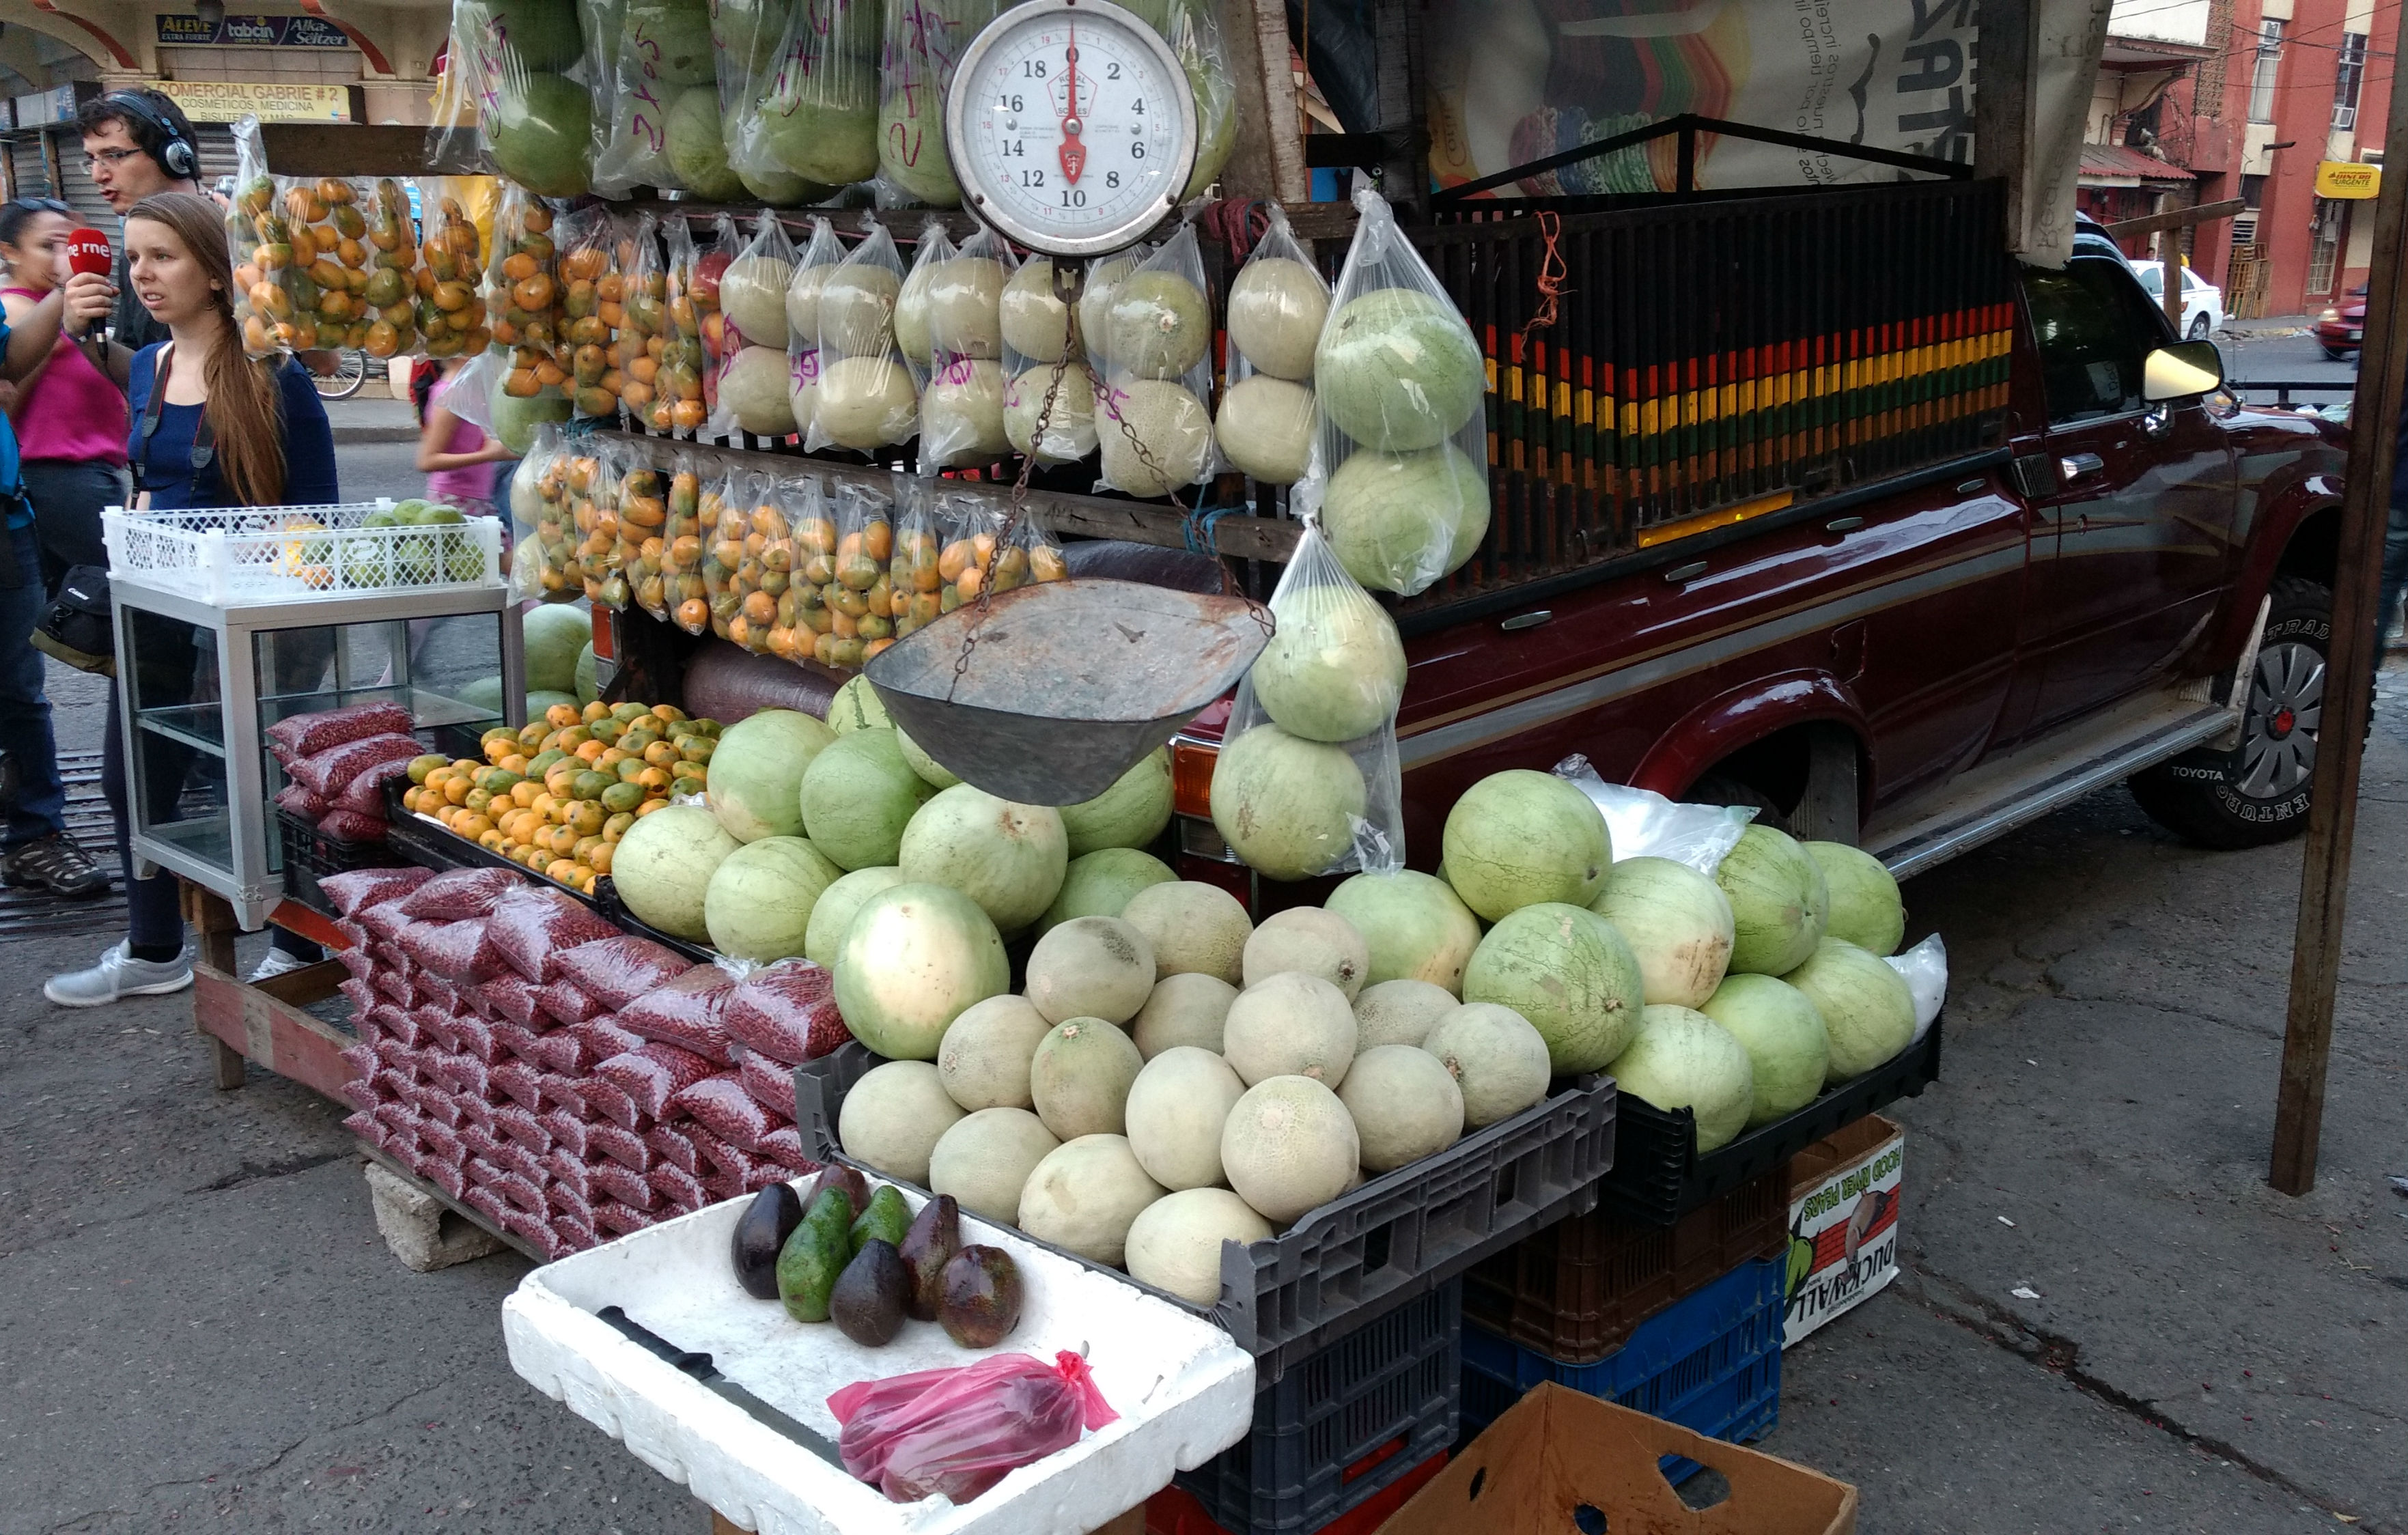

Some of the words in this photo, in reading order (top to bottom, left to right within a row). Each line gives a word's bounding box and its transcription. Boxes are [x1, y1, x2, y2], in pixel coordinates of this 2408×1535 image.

[162, 16, 212, 33] ALEVE
[290, 18, 328, 33] Alka-
[294, 31, 347, 45] Seltzer
[1024, 60, 1046, 78] 18
[1107, 62, 1121, 80] 2
[1059, 74, 1087, 84] ROAL
[157, 83, 250, 98] COMERCIAL
[253, 85, 312, 100] GABRIE
[328, 87, 338, 101] 2
[260, 100, 314, 111] MEDICINA
[1000, 94, 1024, 112] 16
[1131, 98, 1145, 115] 4
[200, 111, 249, 122] BISUTE
[1003, 139, 1024, 156] 14
[1131, 141, 1145, 159] 6
[1022, 170, 1045, 187] 12
[1106, 171, 1120, 188] 8
[1061, 190, 1086, 208] 10
[82, 242, 110, 257] rne
[68, 588, 89, 600] Canon
[2172, 766, 2224, 781] TOYOTA
[1873, 1145, 1902, 1182] HOOD
[1841, 1165, 1871, 1200] RIVER
[1804, 1183, 1839, 1222] PEARS
[1796, 1236, 1894, 1323] DUCKWALL
